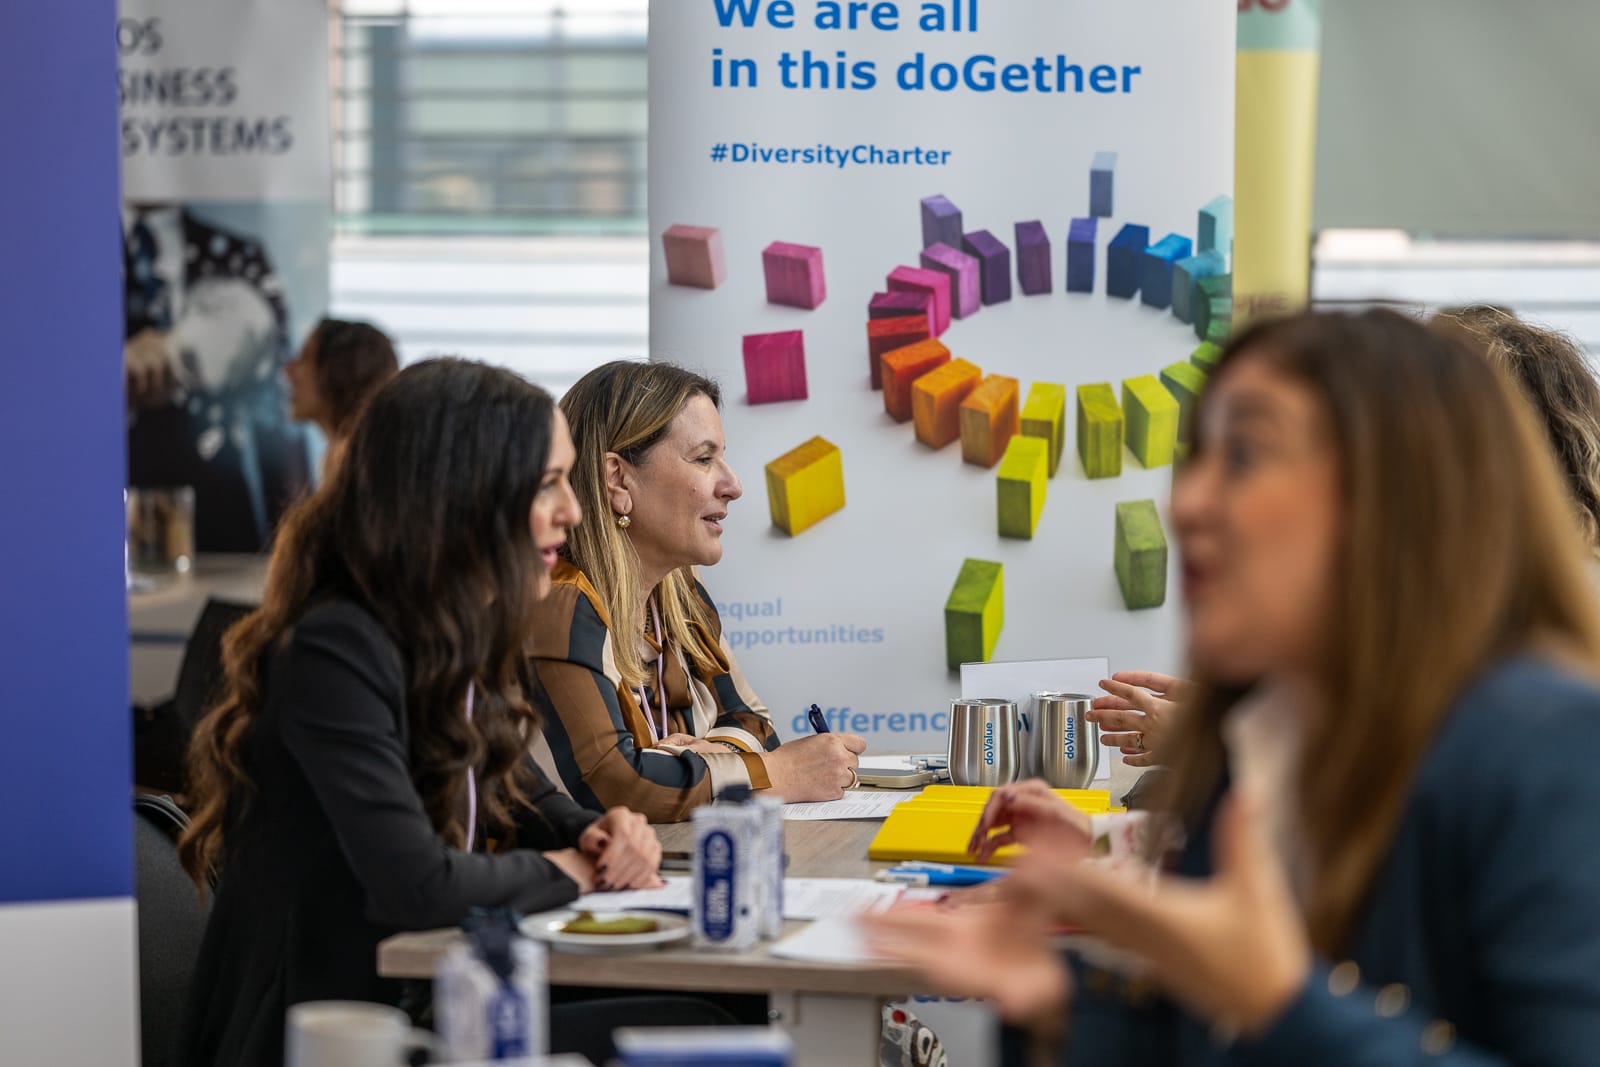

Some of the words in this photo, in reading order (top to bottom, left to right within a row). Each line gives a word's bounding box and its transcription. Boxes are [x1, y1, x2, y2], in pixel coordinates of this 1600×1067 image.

[712, 0, 795, 28] We
[814, 0, 899, 31] are
[918, 0, 978, 32] all
[712, 48, 758, 87] in
[778, 50, 878, 90] this
[896, 52, 1142, 94] doGether
[710, 142, 952, 168] #DiversityCharter
[716, 598, 782, 621] equal
[723, 623, 885, 649] pportunities
[984, 722, 993, 765] doValue
[1064, 716, 1074, 759] doValue
